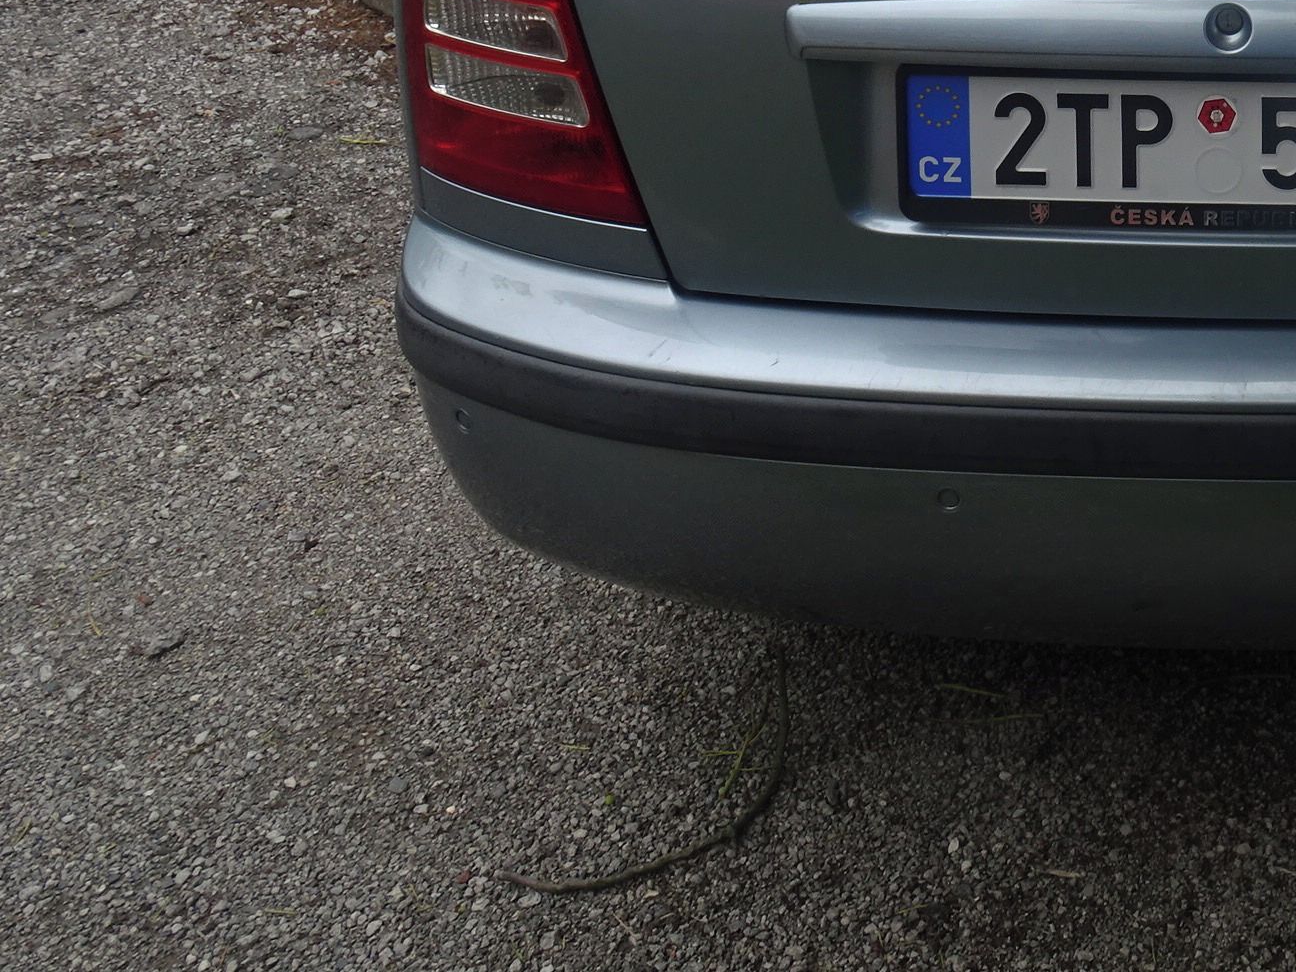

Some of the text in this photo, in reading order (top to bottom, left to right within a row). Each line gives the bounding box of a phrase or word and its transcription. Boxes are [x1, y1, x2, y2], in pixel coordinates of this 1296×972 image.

[993, 91, 1174, 189] 2TP
[919, 155, 962, 183] CZ
[1110, 205, 1195, 226] ČESKÁ
